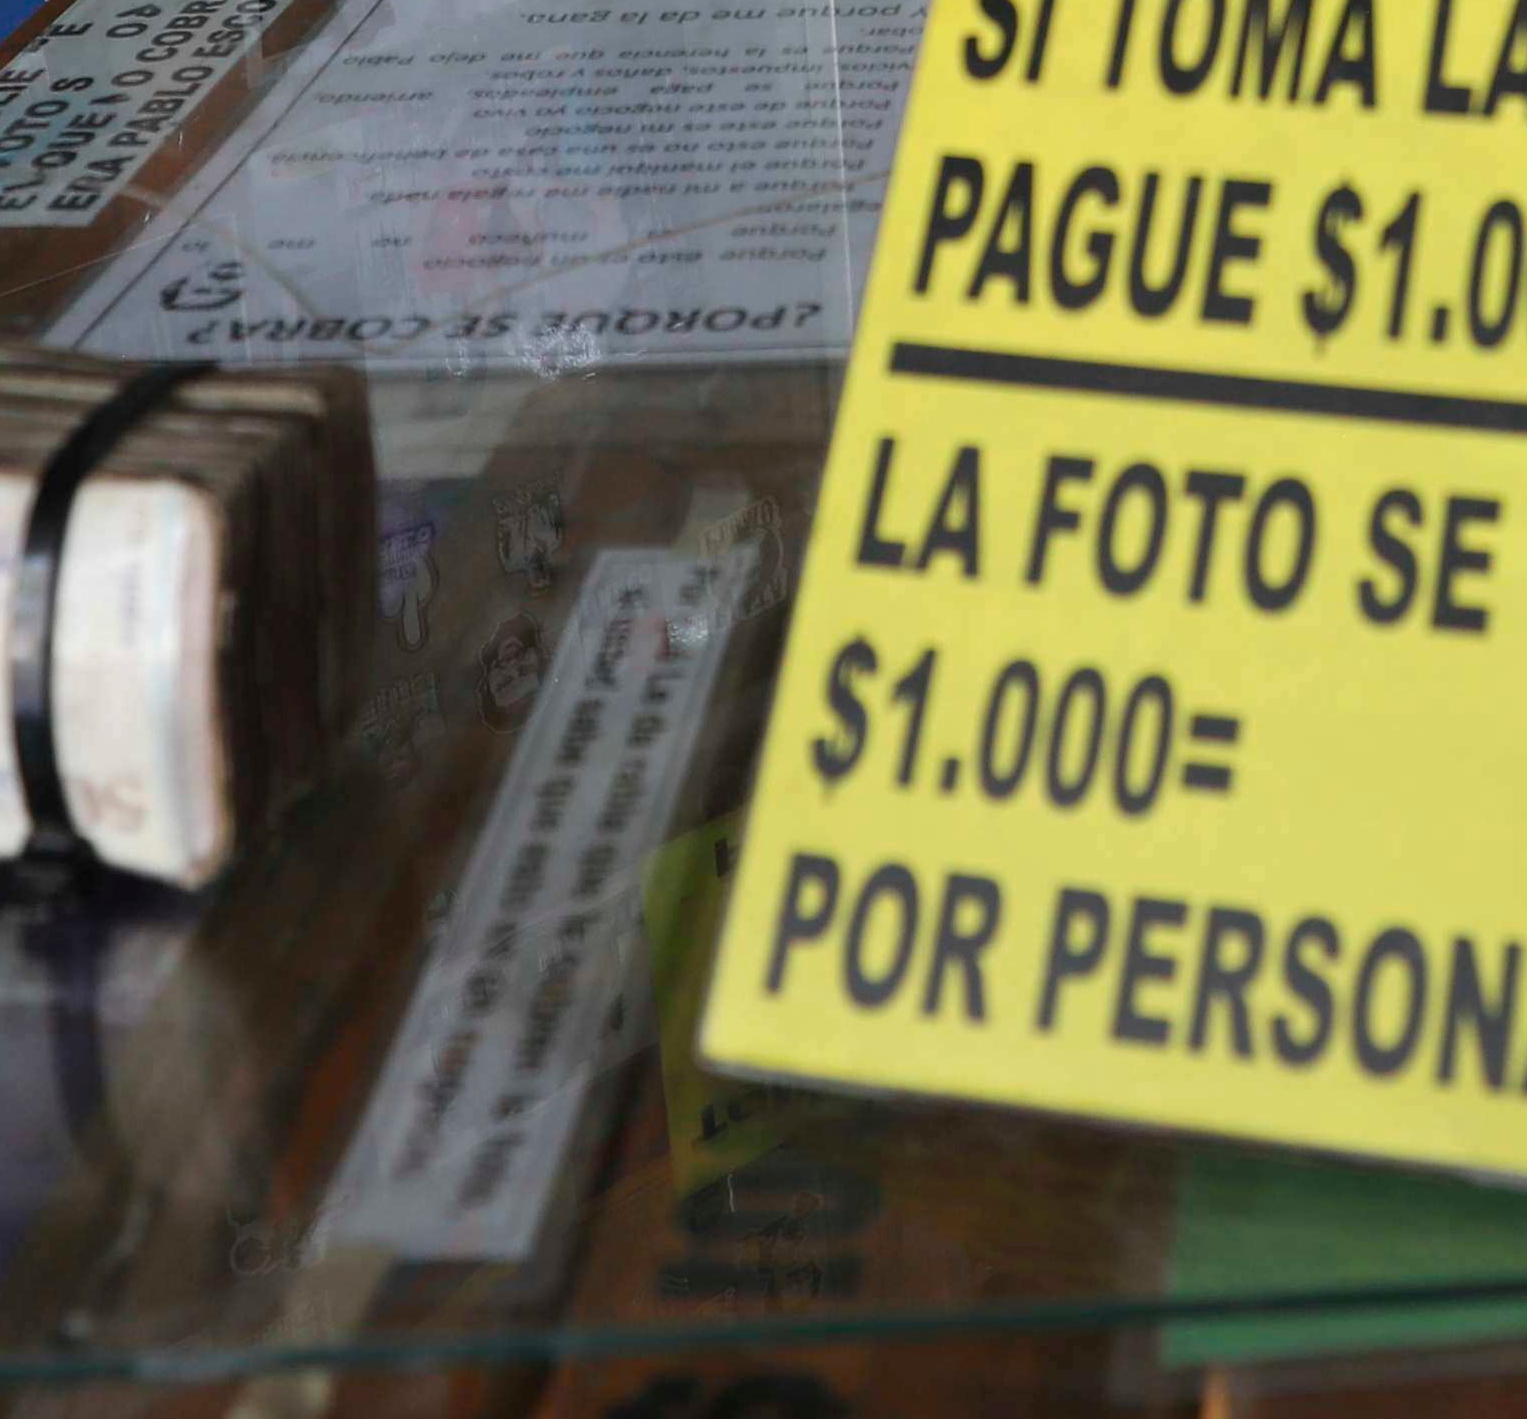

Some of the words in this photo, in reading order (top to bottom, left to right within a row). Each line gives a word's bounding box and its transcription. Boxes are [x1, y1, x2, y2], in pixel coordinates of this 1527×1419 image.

[909, 153, 1273, 324] PAGUE
[853, 435, 984, 578] LA
[1028, 455, 1321, 614] FOTO
[1358, 487, 1499, 633] SE
[809, 633, 1242, 804] $1.000=
[761, 851, 1006, 1026] POR
